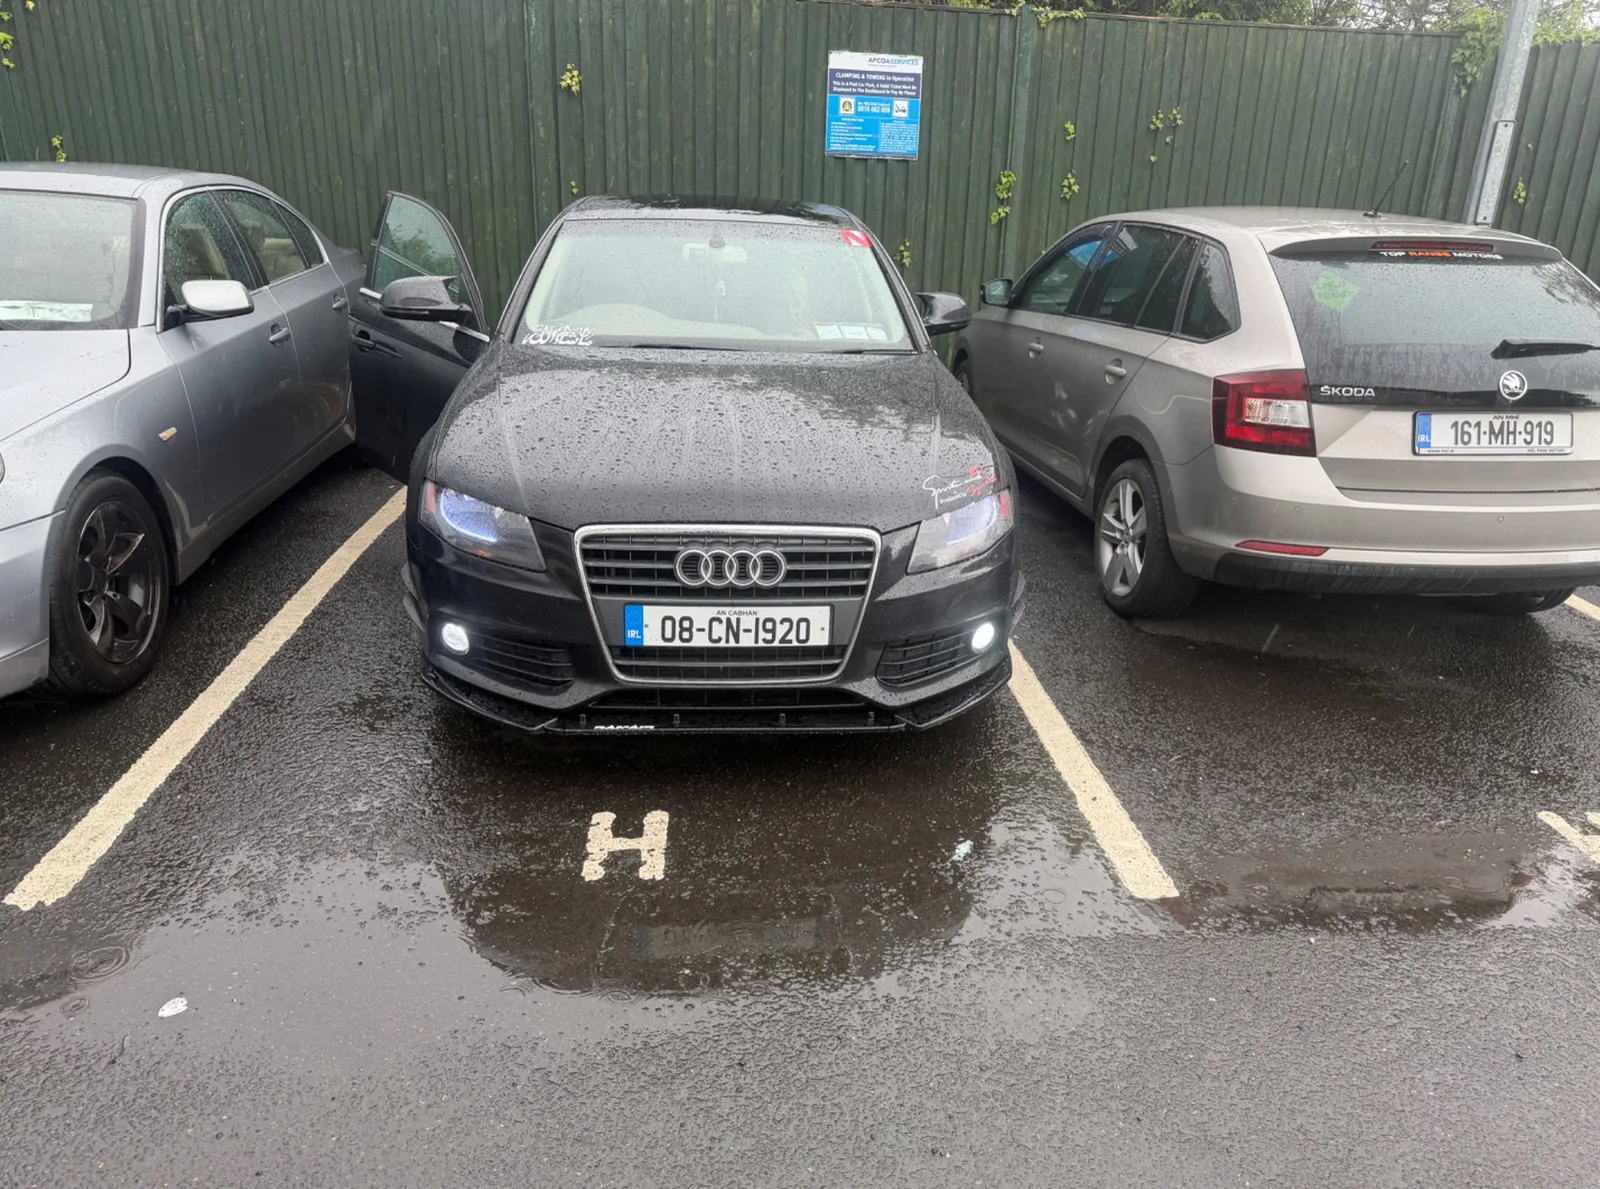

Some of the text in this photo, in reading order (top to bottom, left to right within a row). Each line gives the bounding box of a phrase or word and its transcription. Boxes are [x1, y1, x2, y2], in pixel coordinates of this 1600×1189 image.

[1452, 251, 1503, 259] MOTORS
[1320, 385, 1375, 397] ŠKODA
[1417, 434, 1431, 442] IRL
[627, 629, 641, 639] IRL
[660, 615, 811, 645] 08-CN-1920
[581, 810, 670, 882] H
